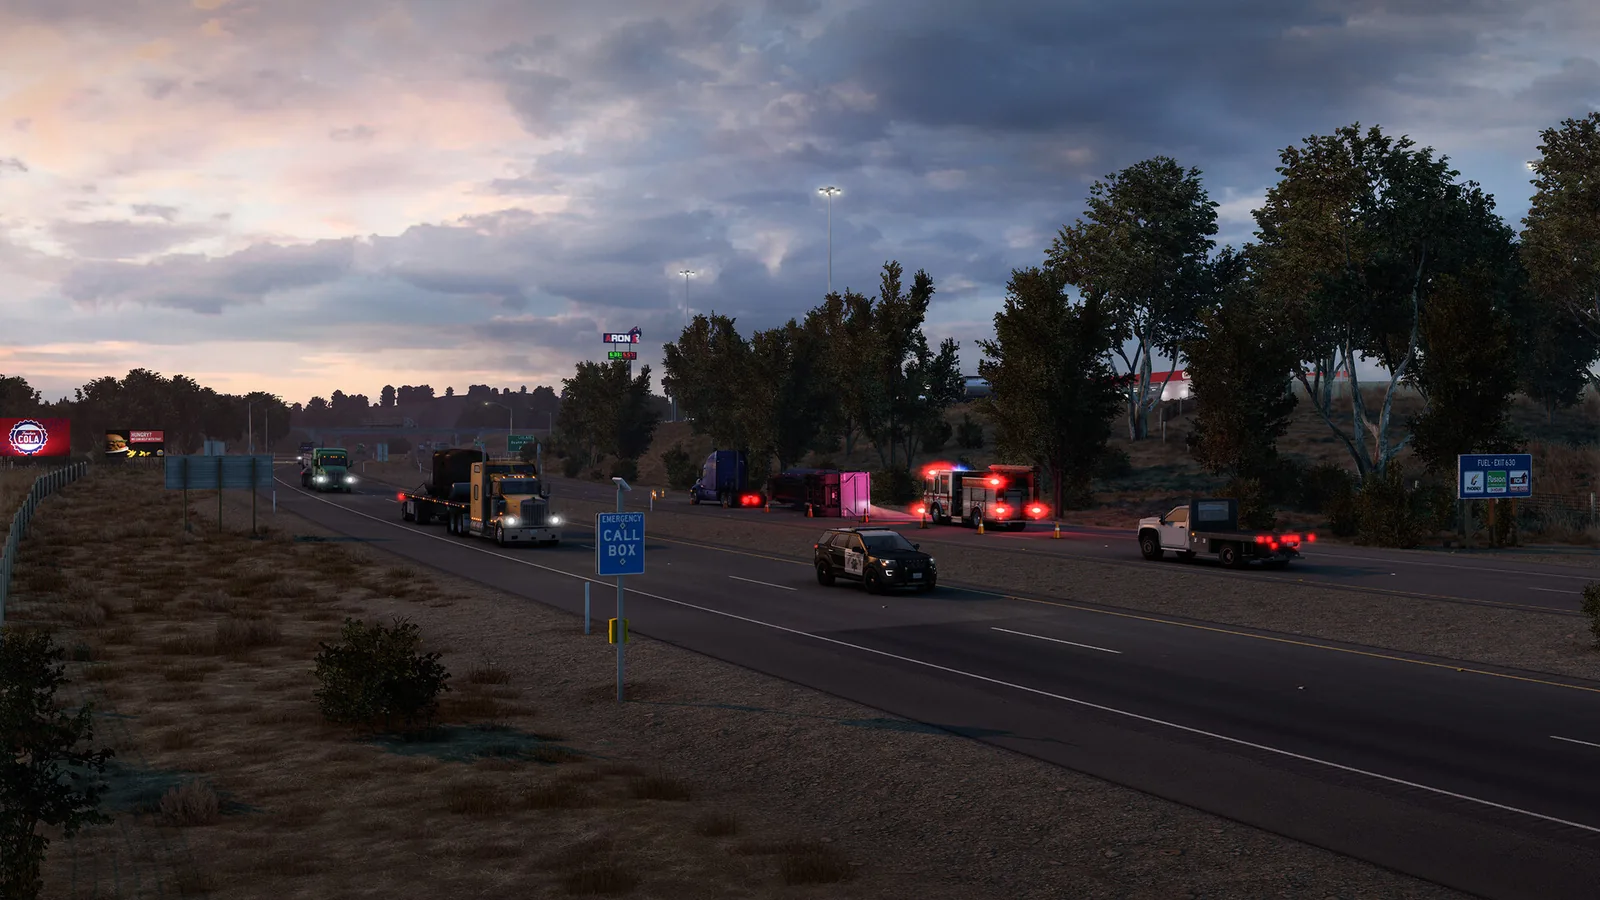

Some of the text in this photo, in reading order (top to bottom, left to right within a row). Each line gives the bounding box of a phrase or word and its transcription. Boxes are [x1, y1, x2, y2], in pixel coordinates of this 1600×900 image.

[605, 334, 631, 342] ARON
[18, 435, 39, 443] COLA
[1505, 458, 1516, 466] 630
[602, 515, 642, 523] EMERGENCY
[603, 529, 640, 541] CALL
[608, 544, 636, 557] BOX
